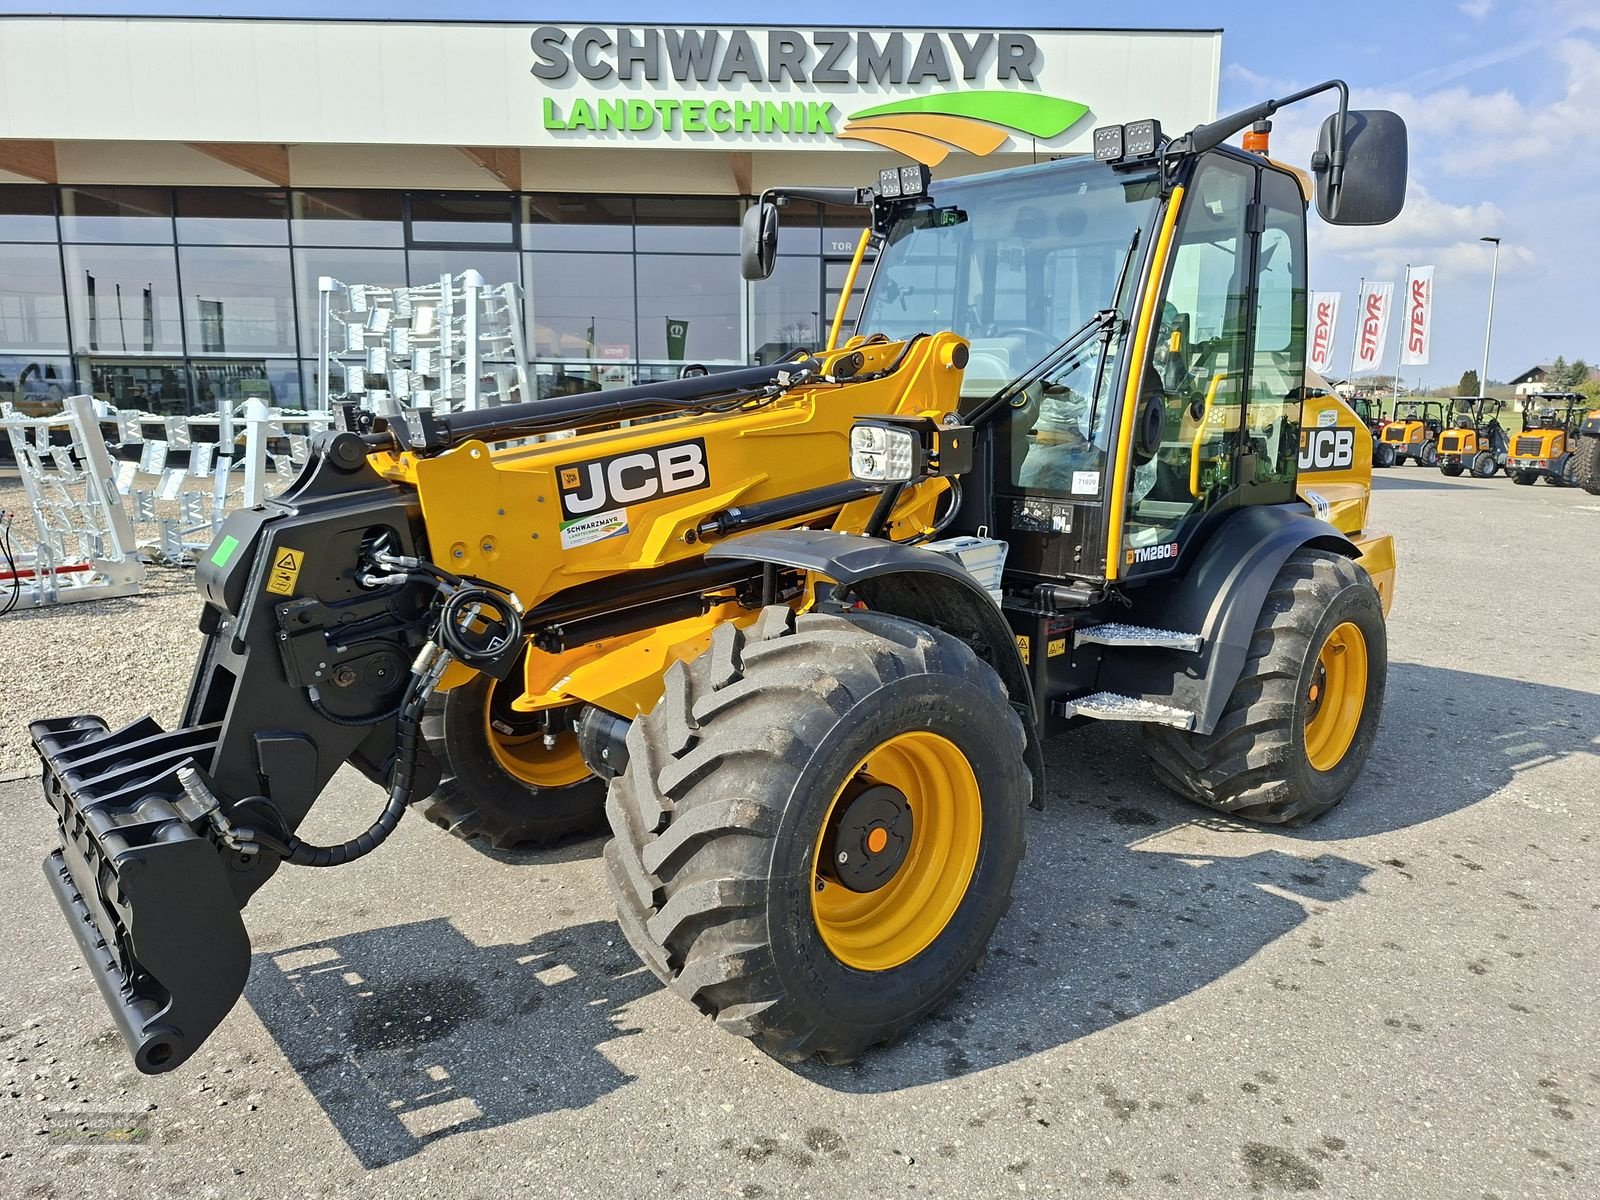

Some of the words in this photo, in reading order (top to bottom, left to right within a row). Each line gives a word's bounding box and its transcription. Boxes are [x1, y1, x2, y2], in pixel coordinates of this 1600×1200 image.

[530, 26, 1037, 84] SCHWARZMAYR
[543, 97, 834, 135] LANDTECHNIK
[832, 241, 852, 251] TOR
[1312, 302, 1331, 364] STEYR
[1361, 293, 1382, 361] STEYR
[1409, 280, 1425, 355] STEYR
[564, 443, 706, 514] JCB
[1298, 430, 1353, 469] JCB
[566, 516, 618, 535] SCHWARZMAYR
